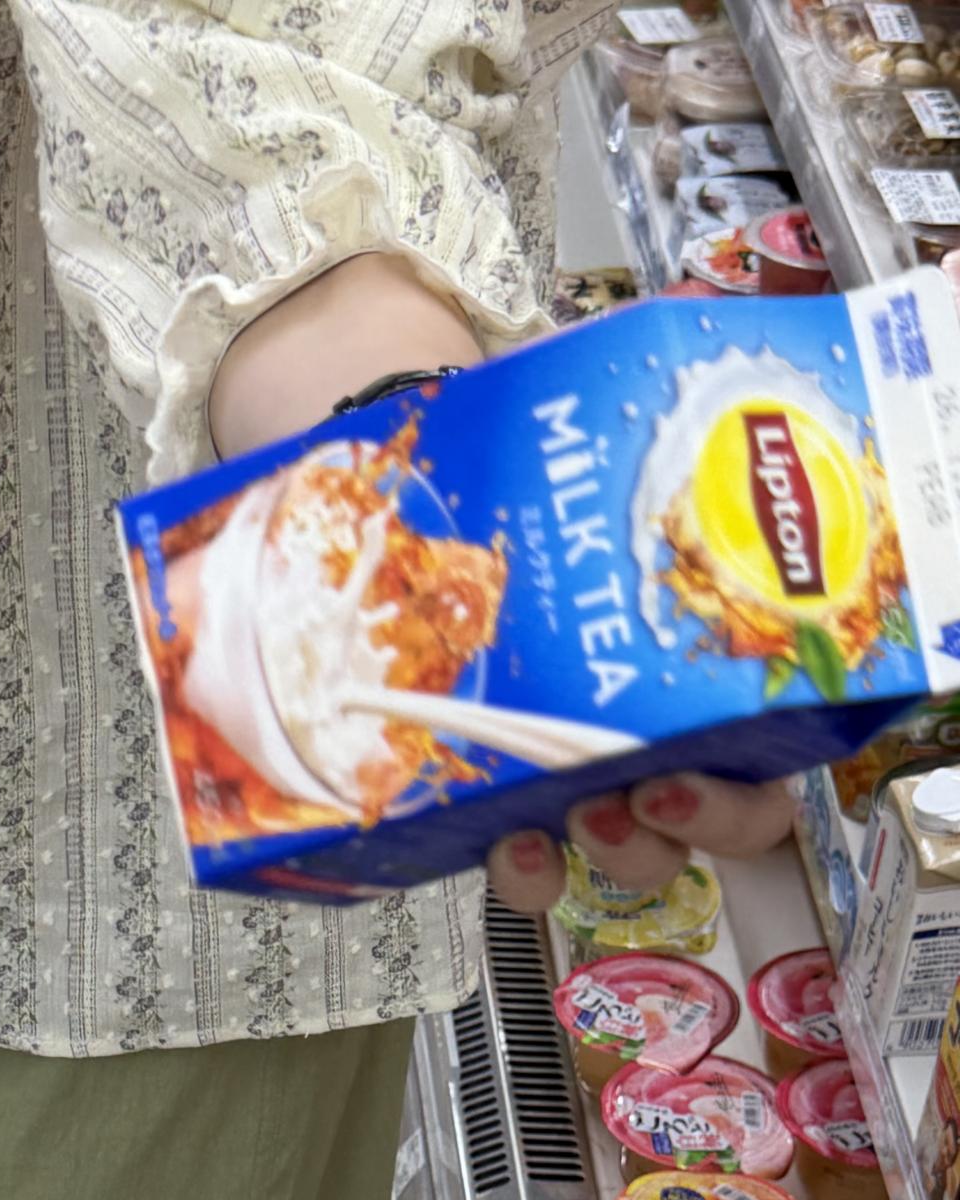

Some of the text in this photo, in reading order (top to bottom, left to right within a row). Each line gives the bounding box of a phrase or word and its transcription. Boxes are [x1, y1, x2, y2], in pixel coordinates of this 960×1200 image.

[532, 394, 638, 708] MILK TEA
[754, 424, 813, 584] Lipton
